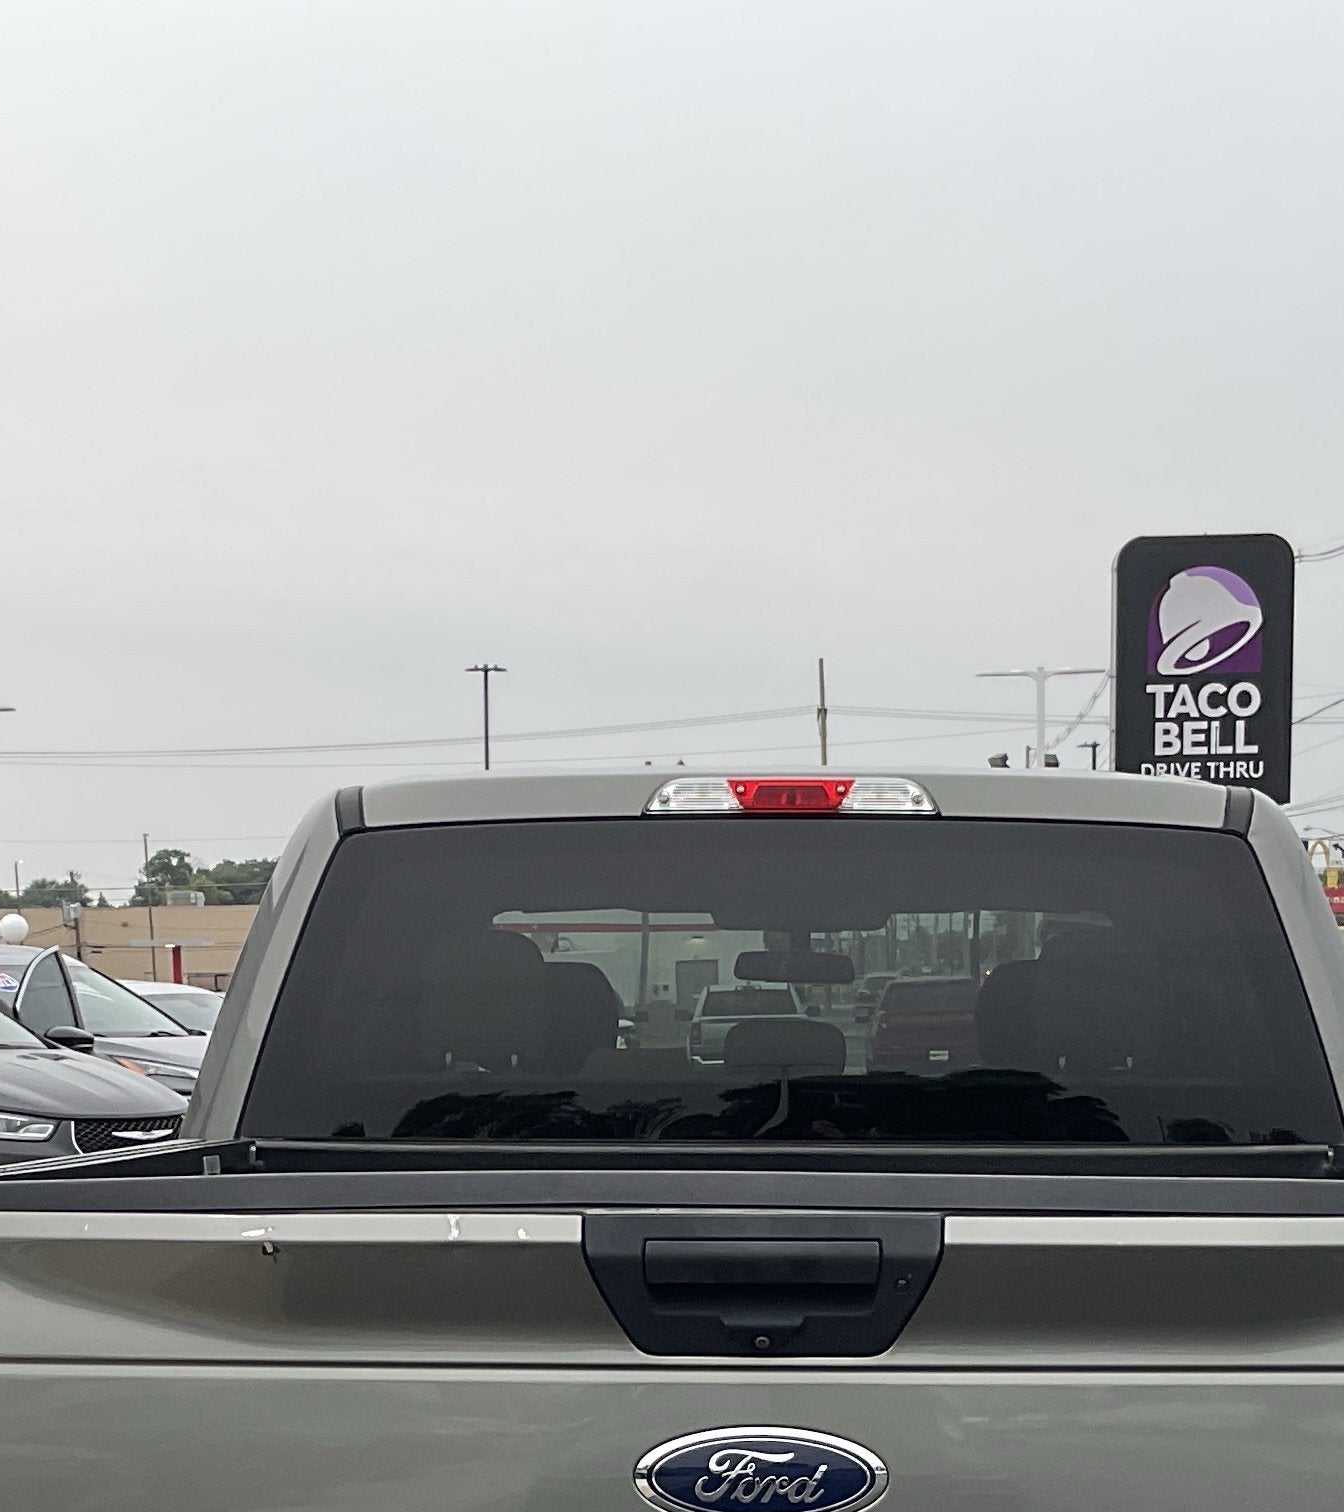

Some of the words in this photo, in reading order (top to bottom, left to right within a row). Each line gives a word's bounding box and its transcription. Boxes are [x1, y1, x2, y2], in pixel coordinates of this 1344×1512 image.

[1145, 681, 1262, 719] TACO
[1154, 720, 1259, 757] BELL
[1140, 762, 1202, 779] DRIVE
[1206, 760, 1265, 779] THRU
[695, 1448, 829, 1505] Ford
